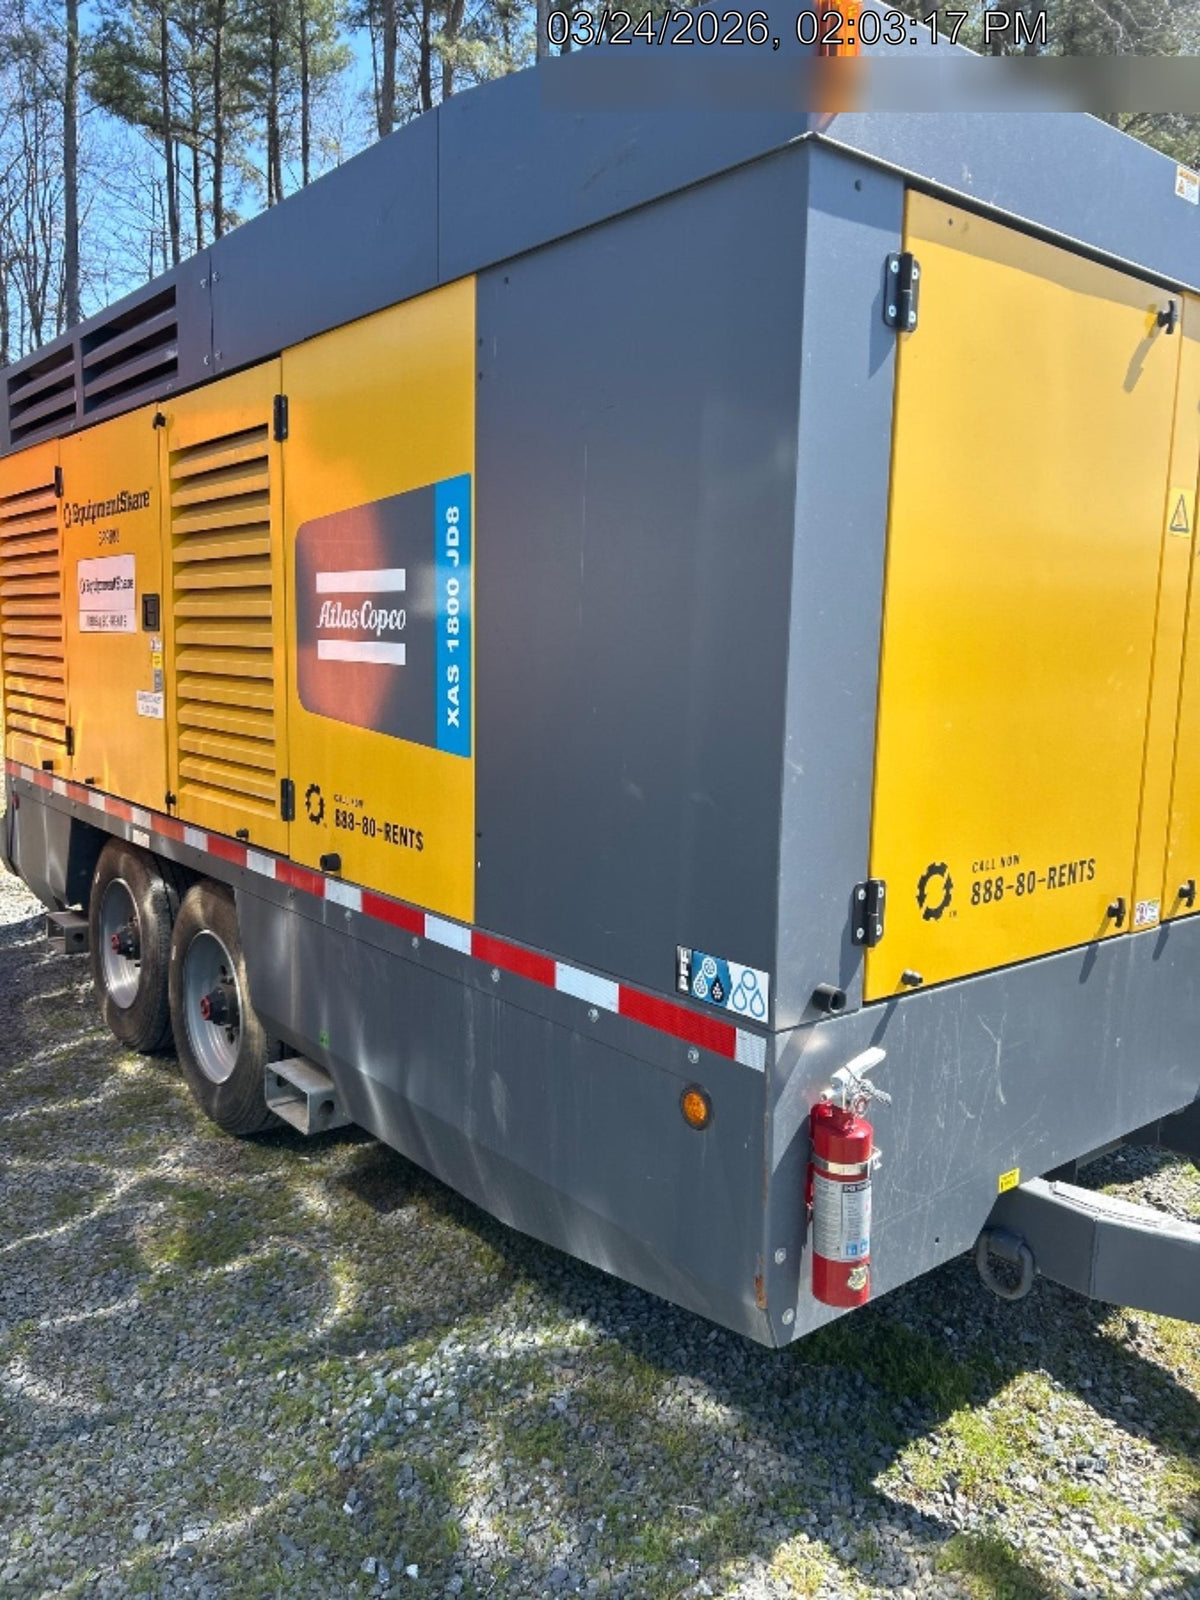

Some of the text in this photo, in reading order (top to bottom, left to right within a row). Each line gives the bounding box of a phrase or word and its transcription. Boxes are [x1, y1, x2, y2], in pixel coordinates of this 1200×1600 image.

[446, 505, 460, 728] XAS 1800 JD8
[335, 808, 424, 852] 888-80-RENTS
[970, 858, 1097, 906] 888-80-RENTS
[972, 854, 1021, 874] CALL NOW
